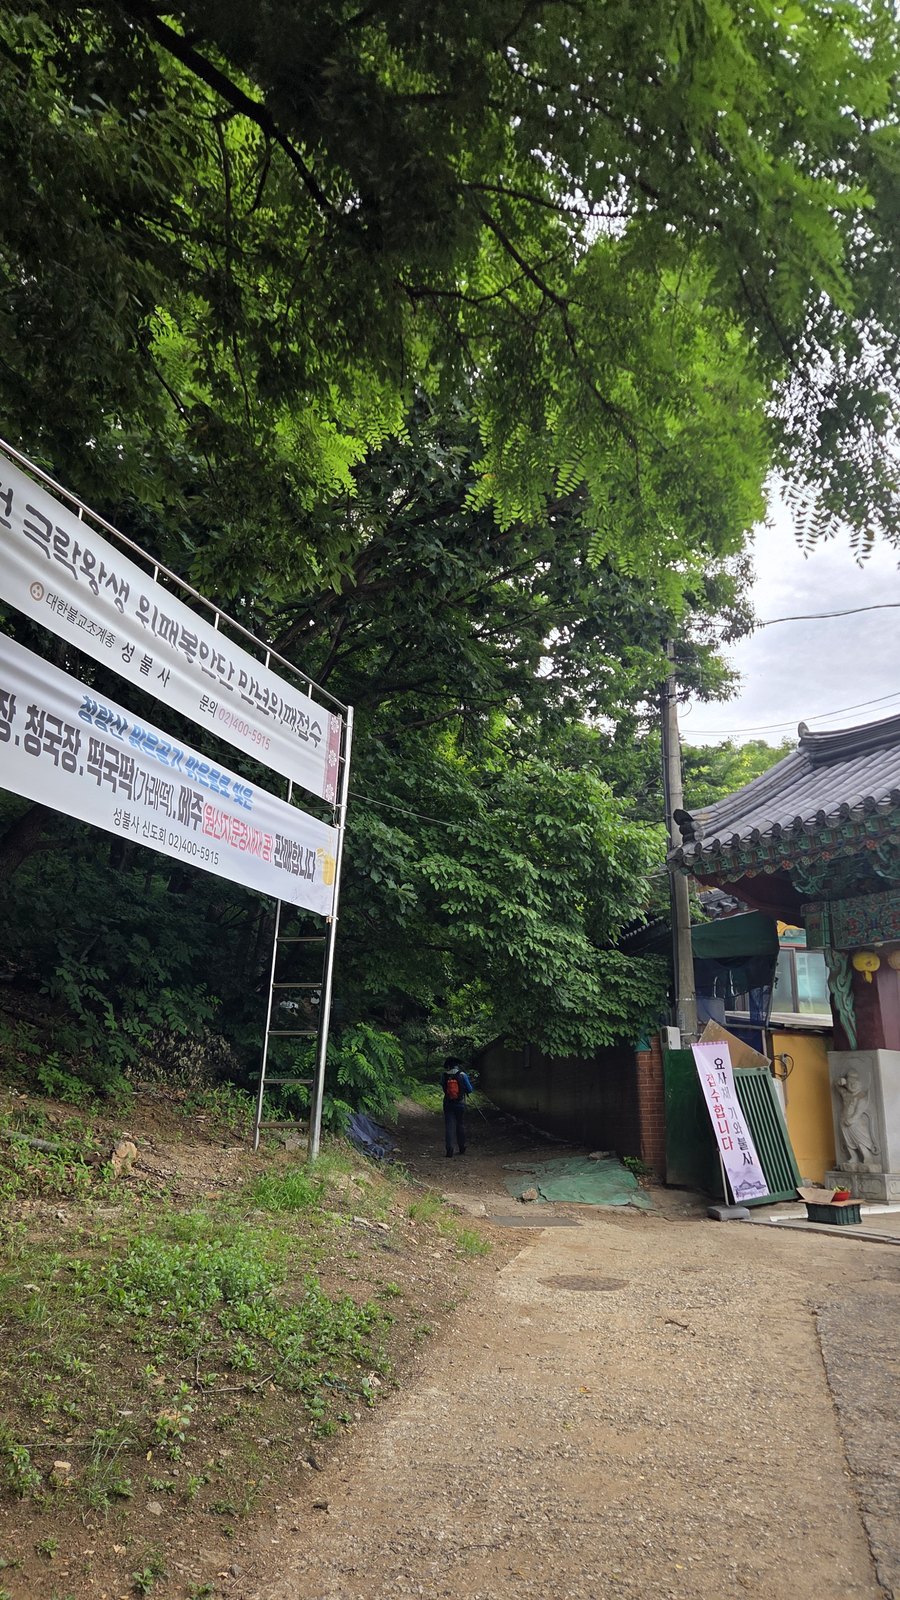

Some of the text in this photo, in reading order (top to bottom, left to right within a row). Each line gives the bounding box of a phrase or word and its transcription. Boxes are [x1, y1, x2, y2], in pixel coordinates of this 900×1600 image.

[22, 503, 130, 614] 극락왕생
[135, 594, 235, 691] 위패봉안단
[238, 669, 322, 748] 만년위패접수
[45, 592, 116, 649] 대한불교조계종
[199, 694, 218, 718] 문의
[218, 707, 271, 751] 02)400-5915
[77, 695, 254, 811] 청량산 맑은공기 맑은물로 빚은
[113, 807, 220, 865] 성불사 신도회 02)400-5915
[273, 833, 316, 882] 판매합니다
[706, 1073, 733, 1150] 접수합니다
